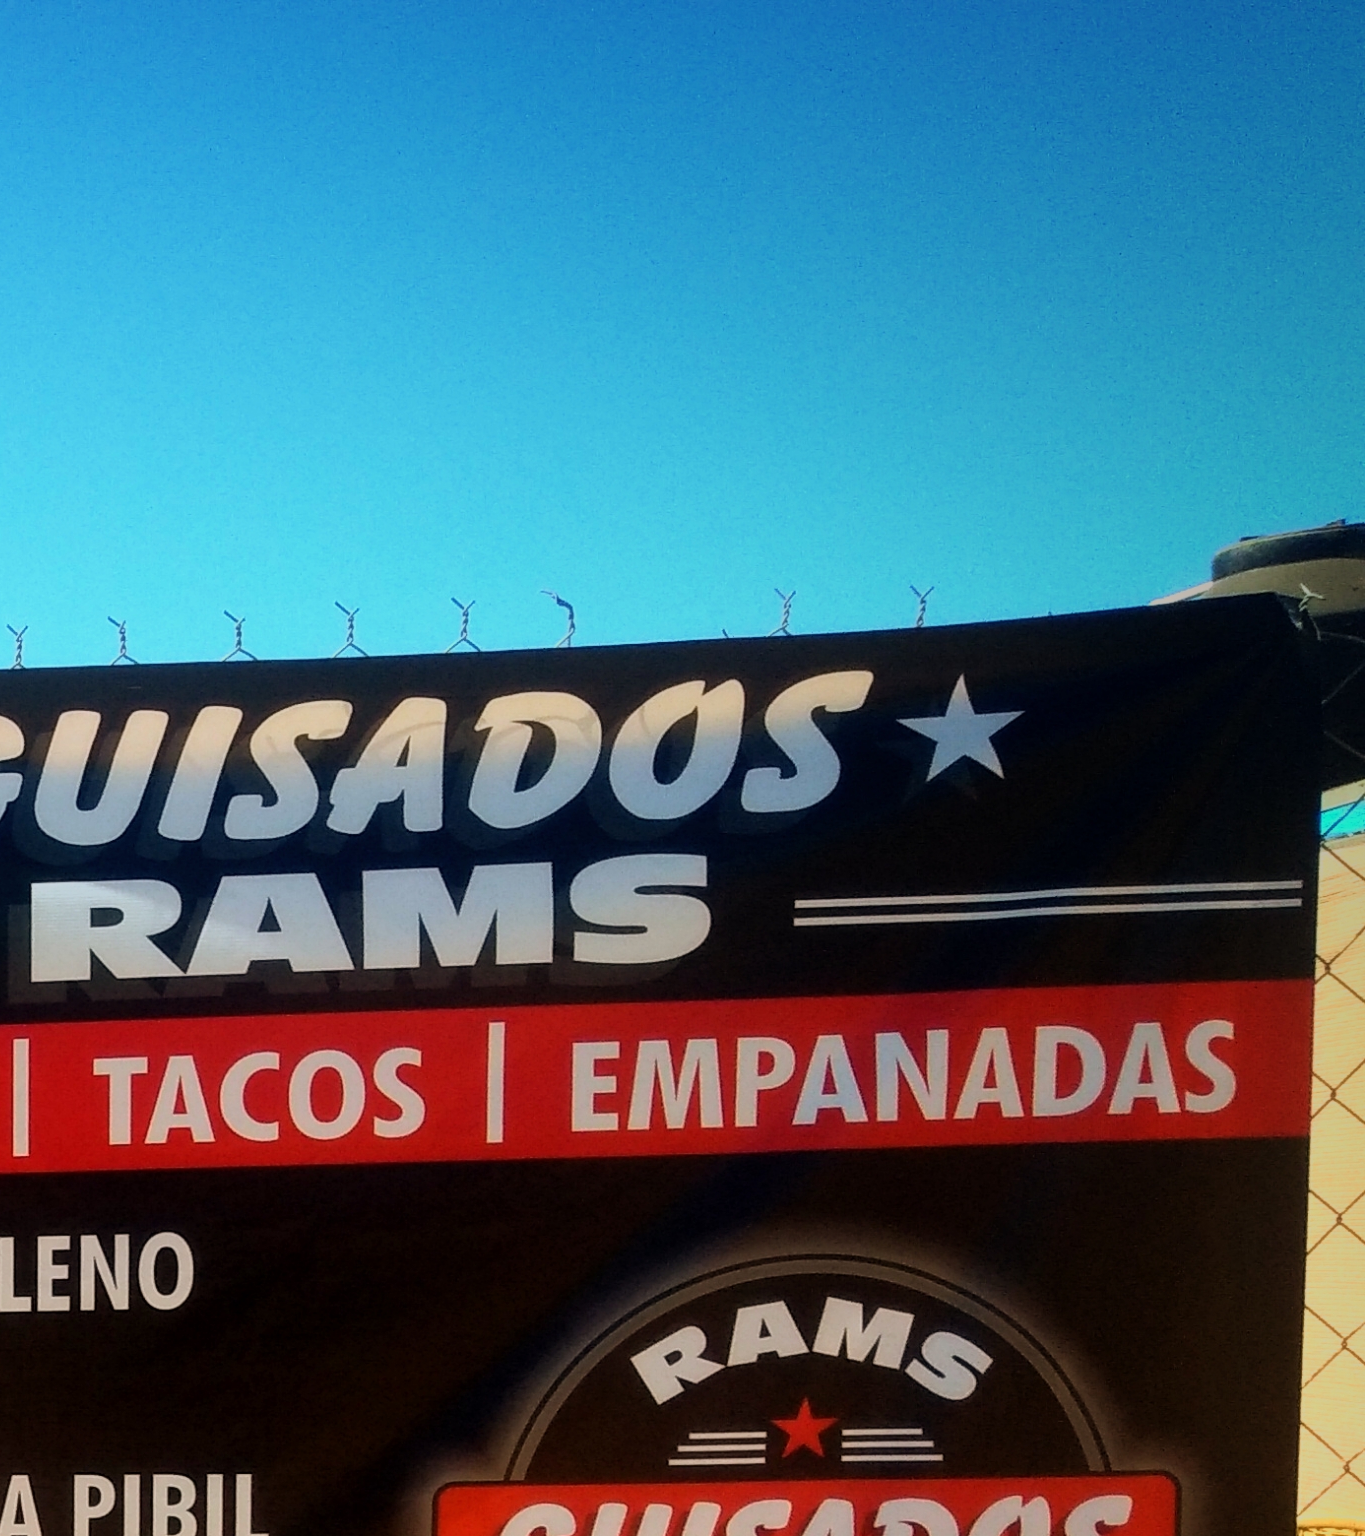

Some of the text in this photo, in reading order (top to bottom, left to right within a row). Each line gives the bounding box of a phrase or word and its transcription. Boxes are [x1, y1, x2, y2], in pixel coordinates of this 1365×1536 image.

[31, 854, 711, 982] RAMS
[94, 1047, 425, 1145] TACOS
[572, 1020, 1236, 1131] EMPANADAS
[631, 1297, 993, 1404] RAMS
